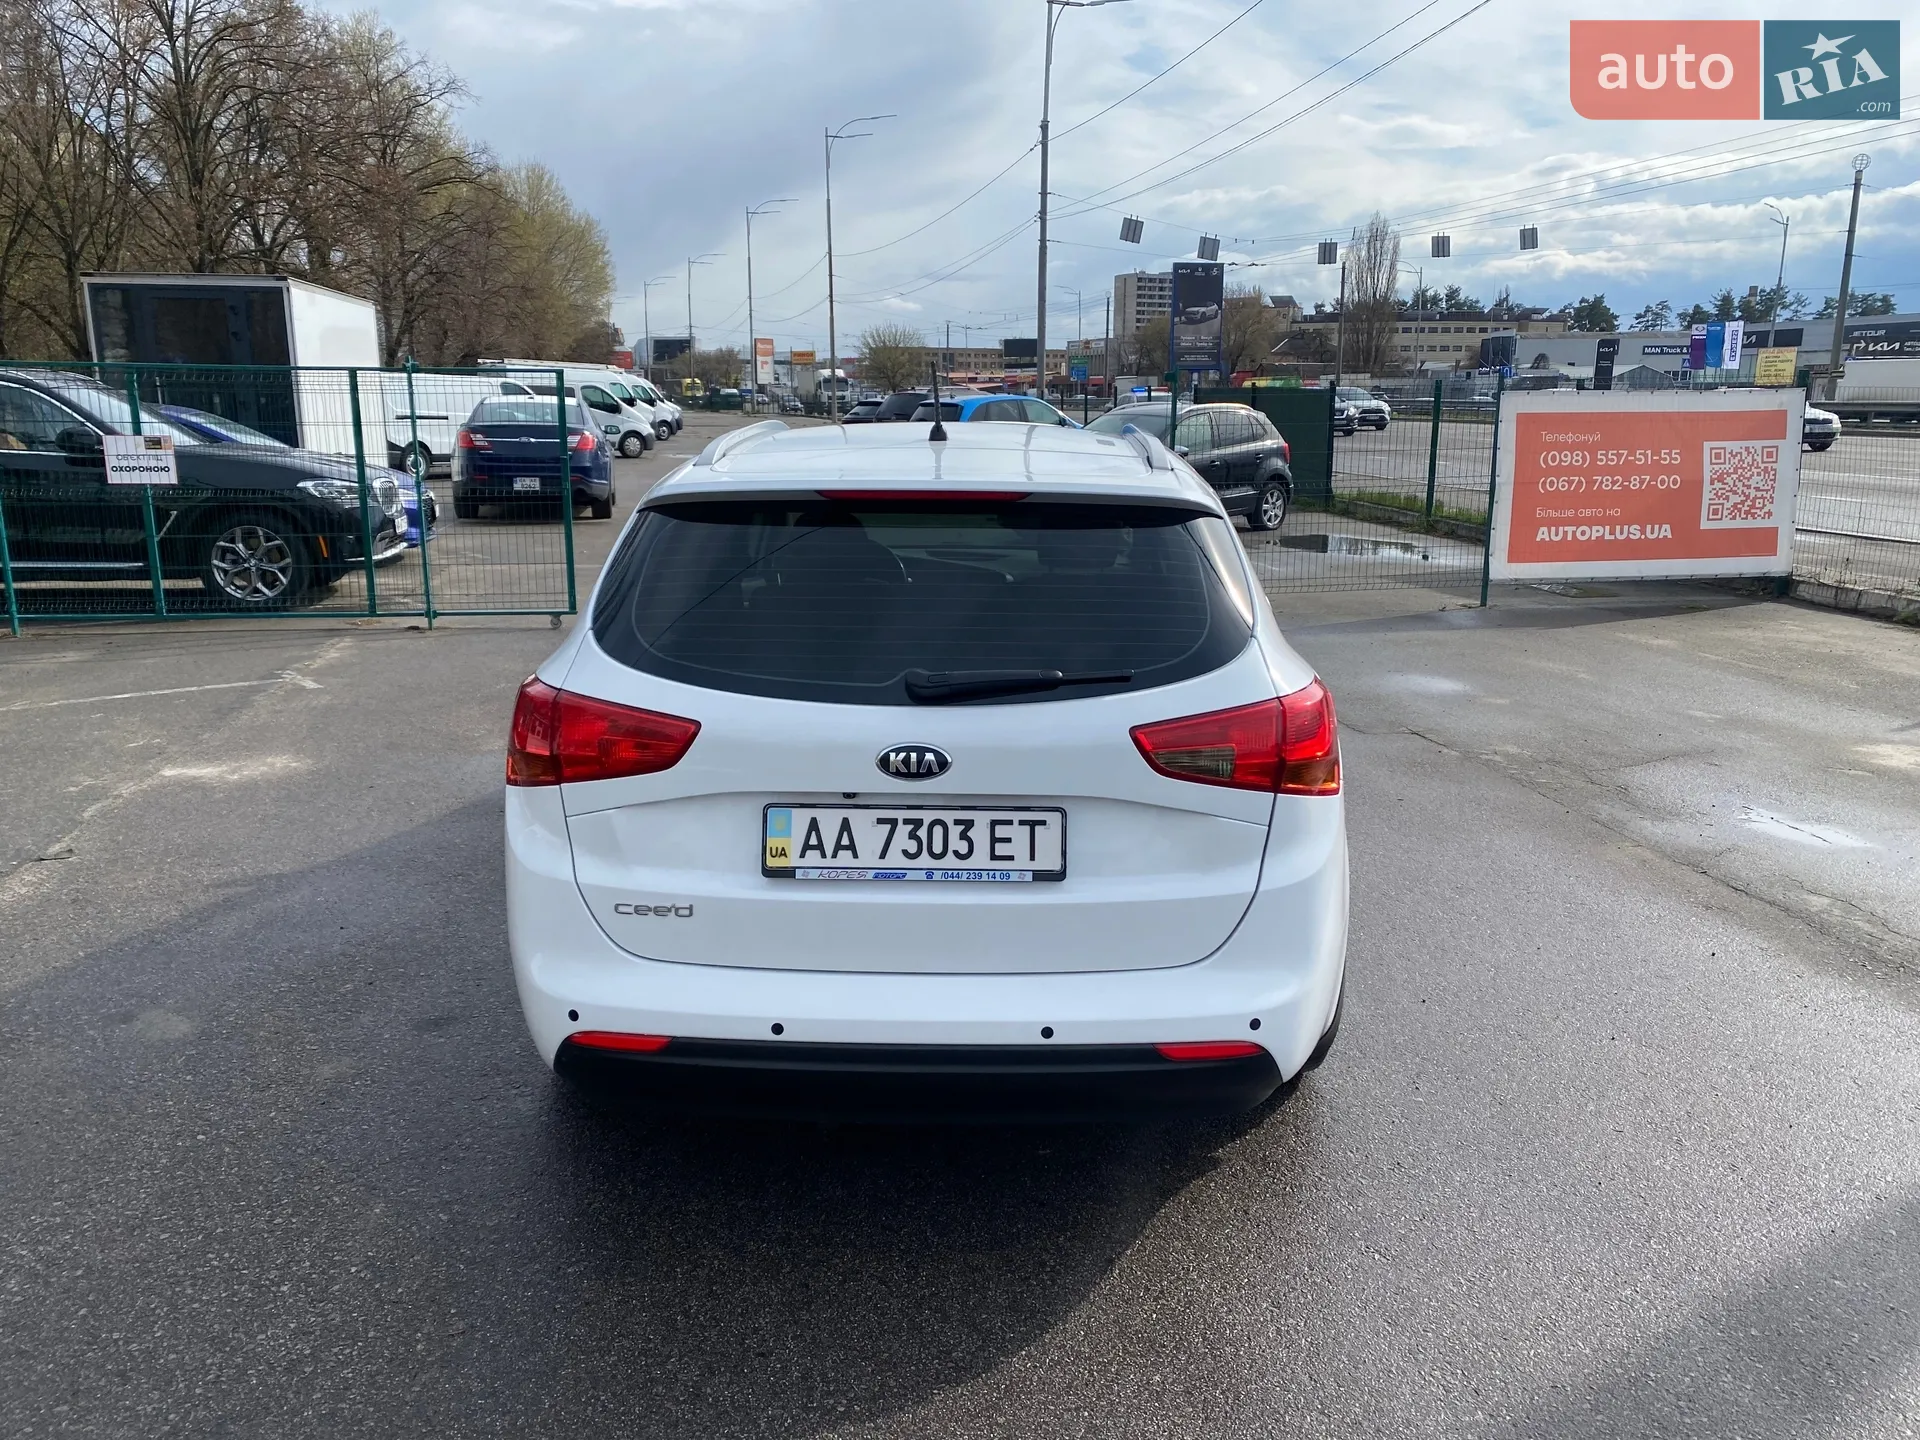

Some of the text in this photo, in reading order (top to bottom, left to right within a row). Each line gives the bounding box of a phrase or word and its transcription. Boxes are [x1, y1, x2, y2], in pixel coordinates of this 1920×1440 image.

[1849, 329, 1886, 338] JETOUR
[1540, 432, 1601, 444] Телефонуй
[1539, 450, 1681, 468] (098) 557-51-55
[1538, 475, 1681, 493] (067) 782-87-00
[1536, 507, 1621, 518] Більше авто на
[1535, 524, 1672, 541] AUTOPLUS.UA
[888, 752, 940, 773] KIA
[799, 817, 1047, 862] AA 7303 ET
[769, 846, 788, 859] UA
[817, 870, 869, 880] КОРЕЯ
[940, 871, 1011, 881] /044/ 239 14 09
[614, 903, 694, 918] cee'd
